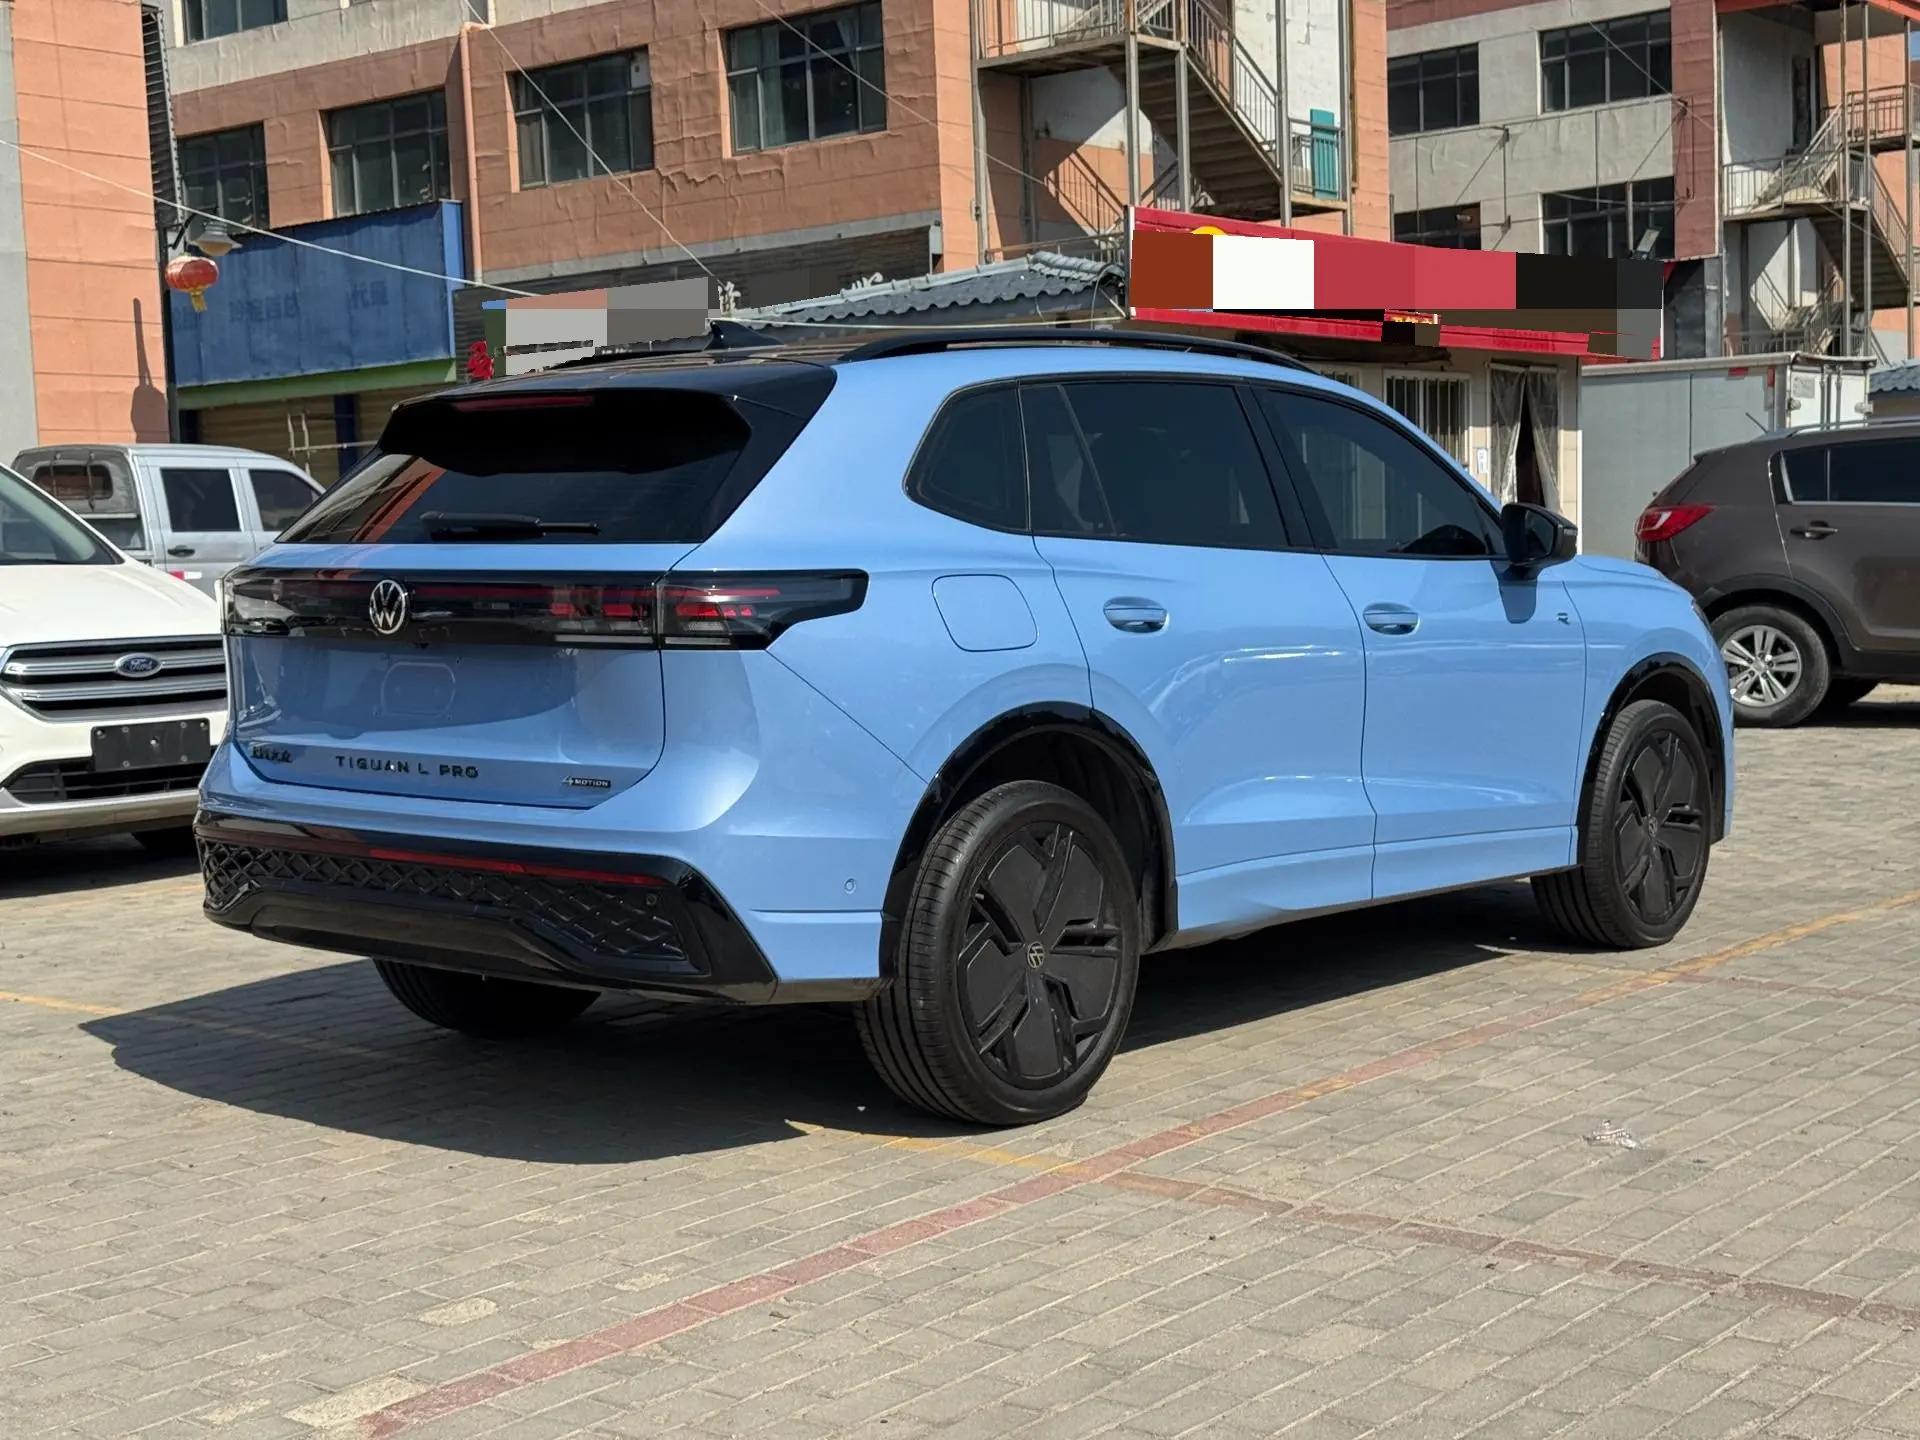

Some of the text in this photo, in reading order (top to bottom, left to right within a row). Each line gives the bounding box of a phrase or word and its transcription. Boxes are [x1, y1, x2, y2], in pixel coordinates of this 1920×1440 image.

[130, 658, 153, 671] Ford
[335, 755, 480, 779] TIGUAN L PRO
[560, 775, 610, 788] 4MOTION
